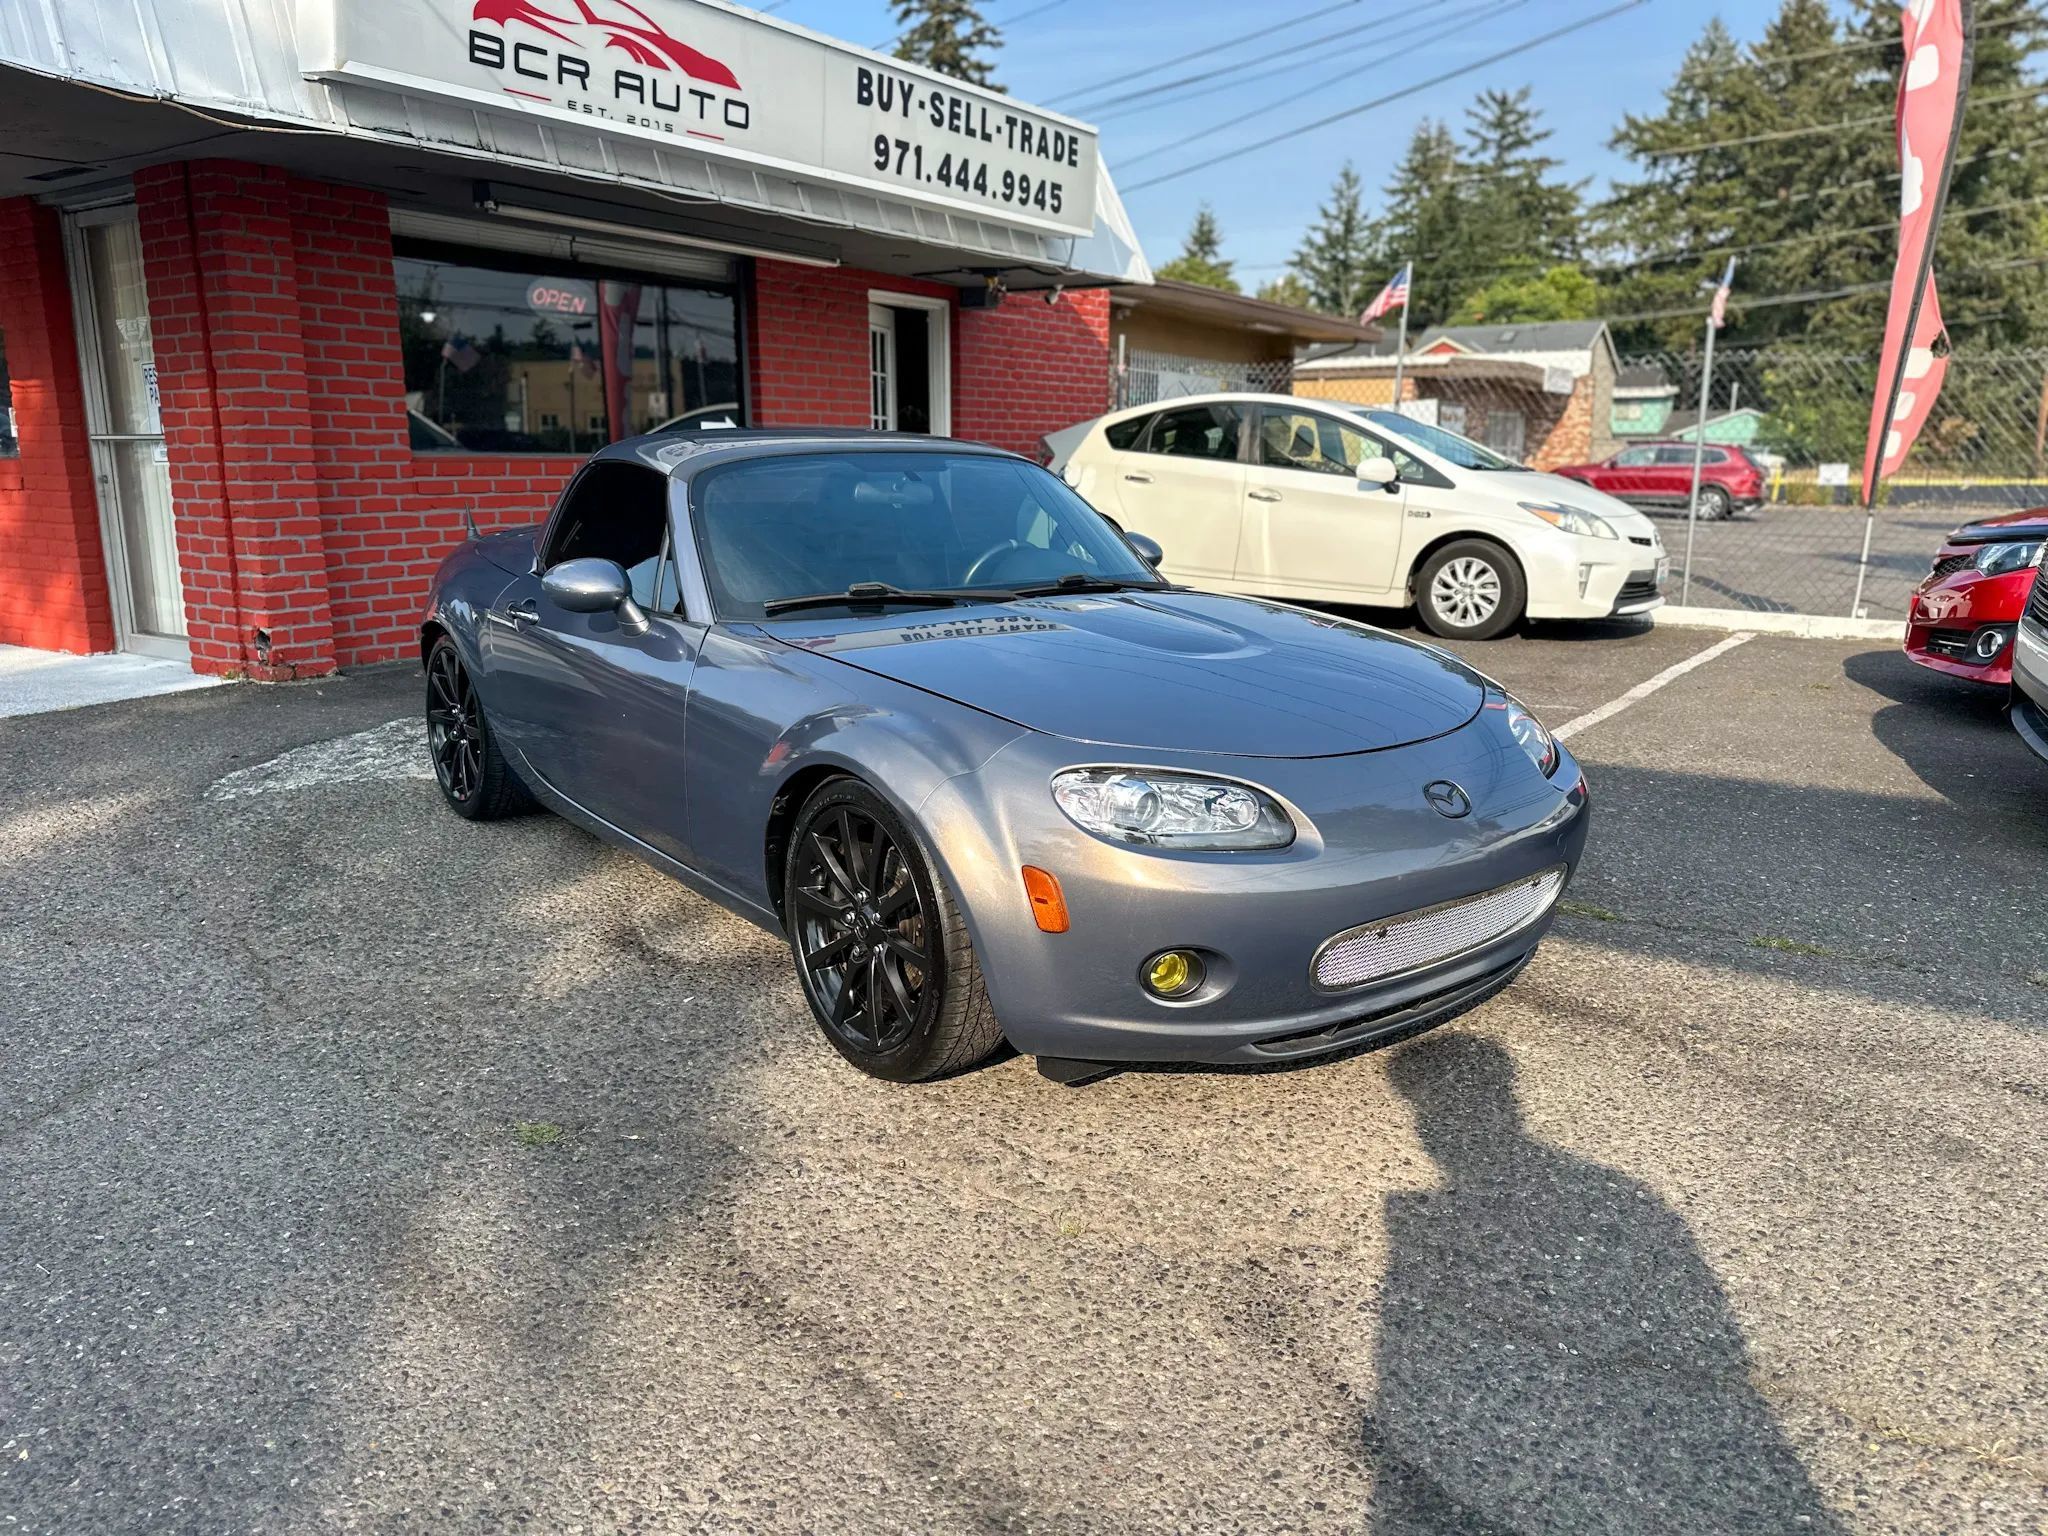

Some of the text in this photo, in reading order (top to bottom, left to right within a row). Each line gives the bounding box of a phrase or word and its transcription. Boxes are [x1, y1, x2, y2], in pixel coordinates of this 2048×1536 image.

[469, 29, 749, 130] BCR AUTO
[567, 99, 674, 133] EST. 2015
[857, 66, 1079, 168] BUY-SELL-TRADE
[873, 134, 1063, 214] 971.444.9945
[532, 287, 586, 315] OPEN
